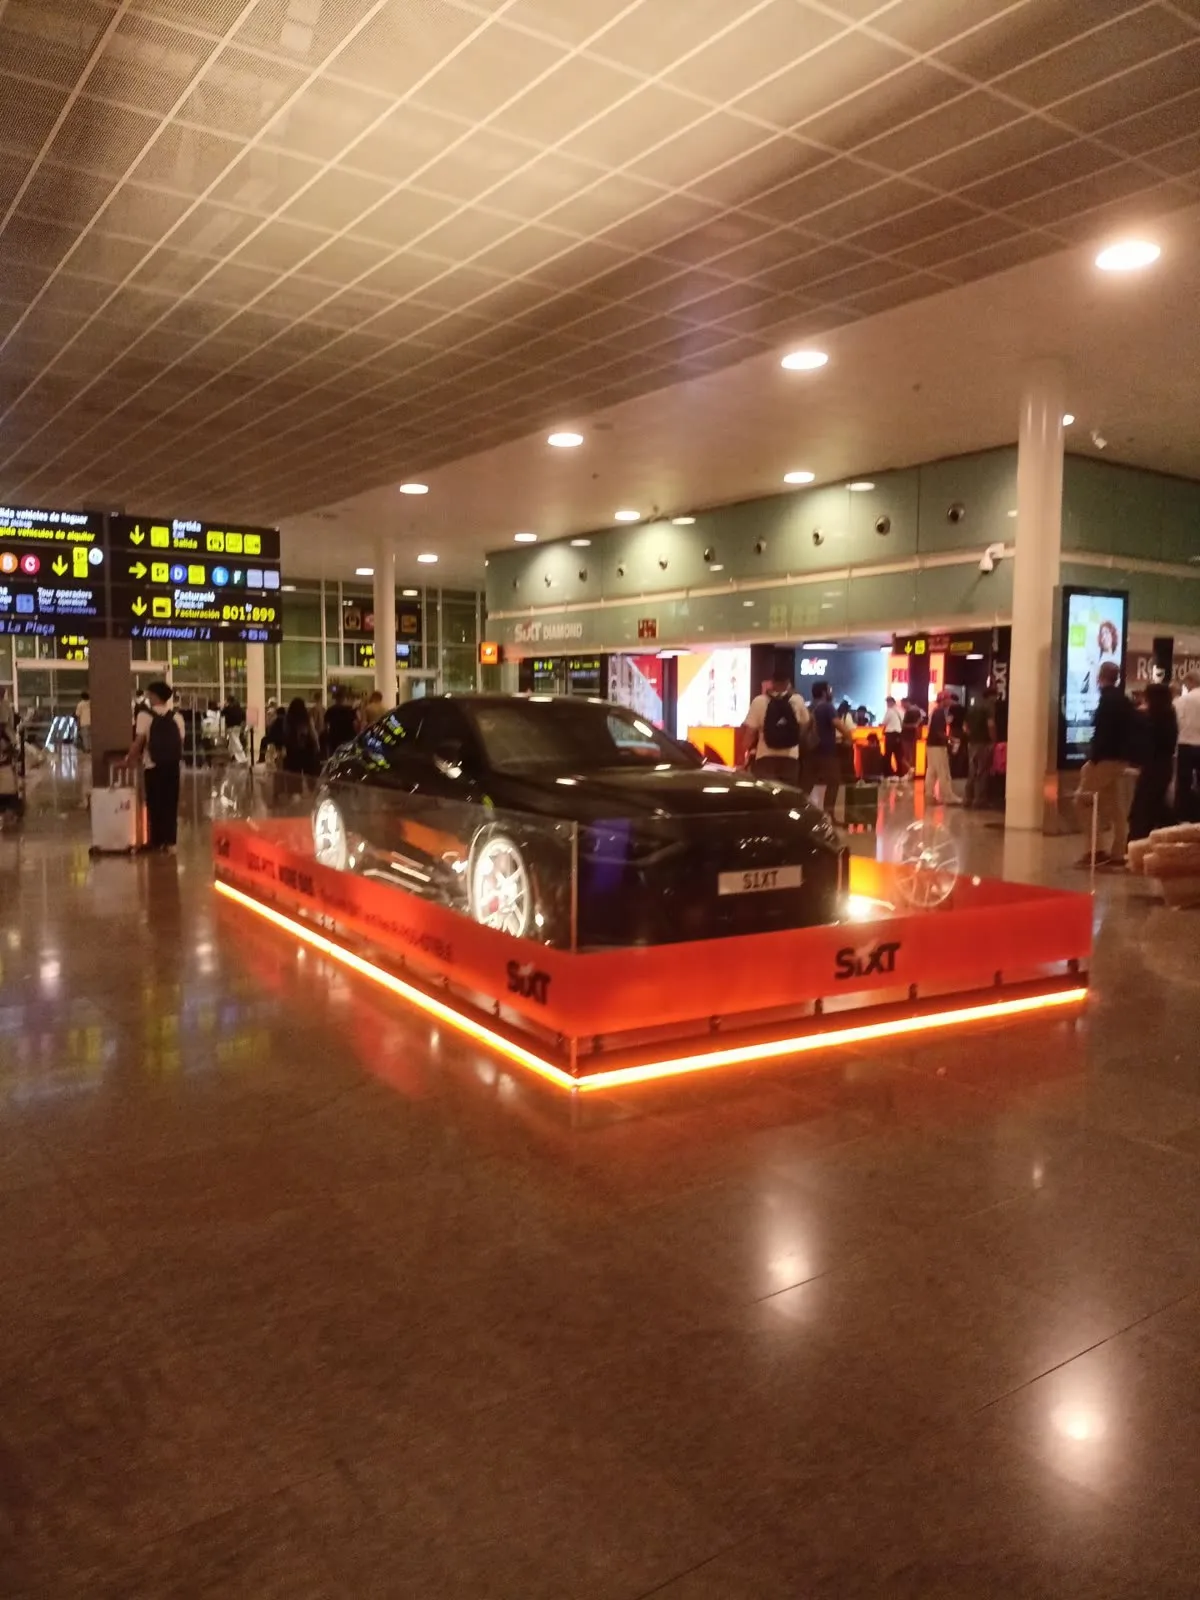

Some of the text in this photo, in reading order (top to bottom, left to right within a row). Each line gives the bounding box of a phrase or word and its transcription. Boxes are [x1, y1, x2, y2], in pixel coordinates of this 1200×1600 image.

[50, 511, 60, 523] de
[55, 529, 66, 540] de
[174, 538, 198, 549] Salida
[37, 586, 55, 598] Tour
